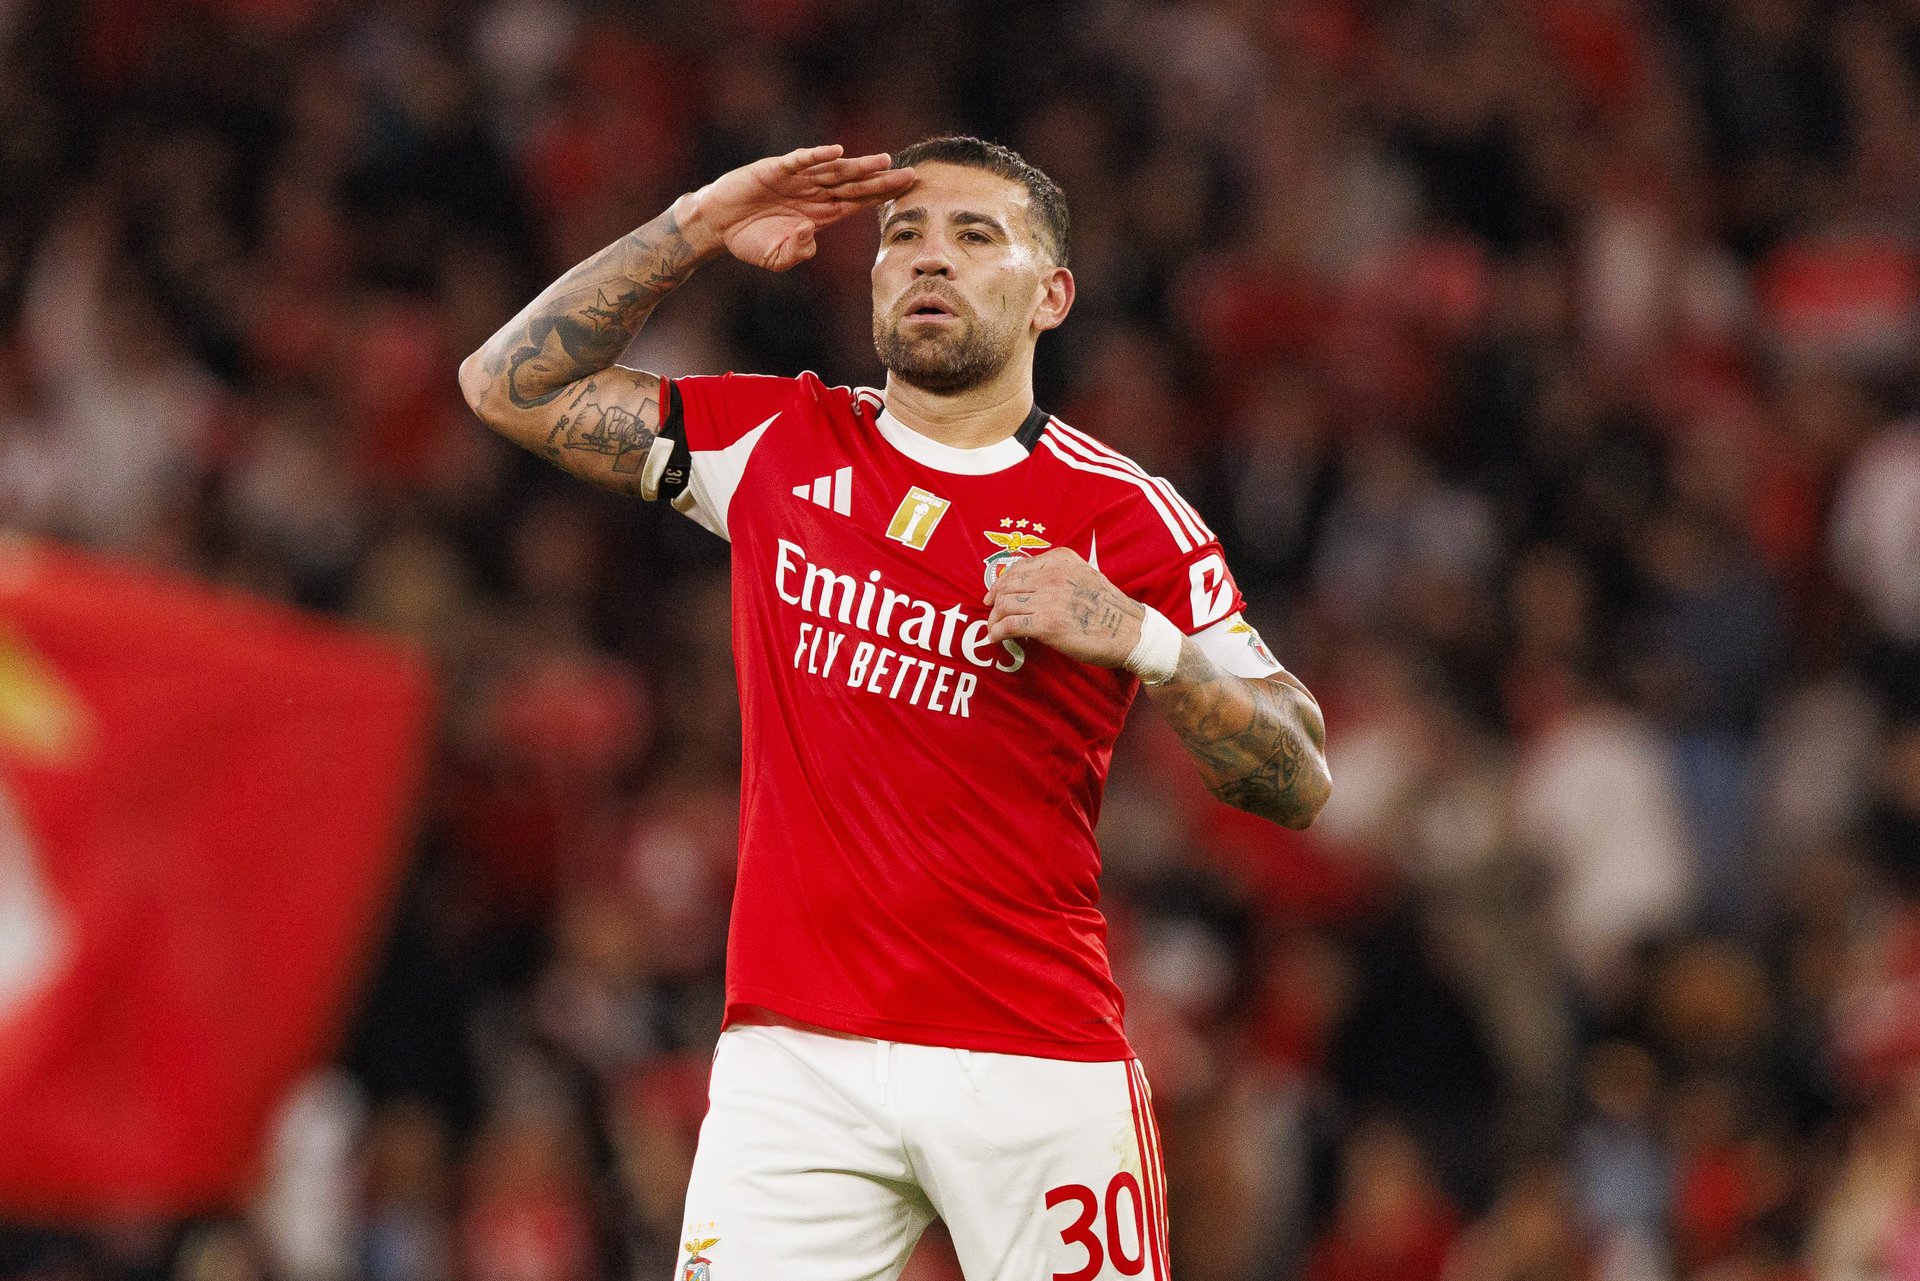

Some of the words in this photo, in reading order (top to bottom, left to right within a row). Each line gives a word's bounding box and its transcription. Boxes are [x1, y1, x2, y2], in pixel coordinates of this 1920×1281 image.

[665, 468, 683, 484] 30
[775, 538, 1025, 673] Emirates
[794, 622, 846, 678] FLY
[846, 641, 978, 718] BETTER
[1045, 1171, 1145, 1281] 30
